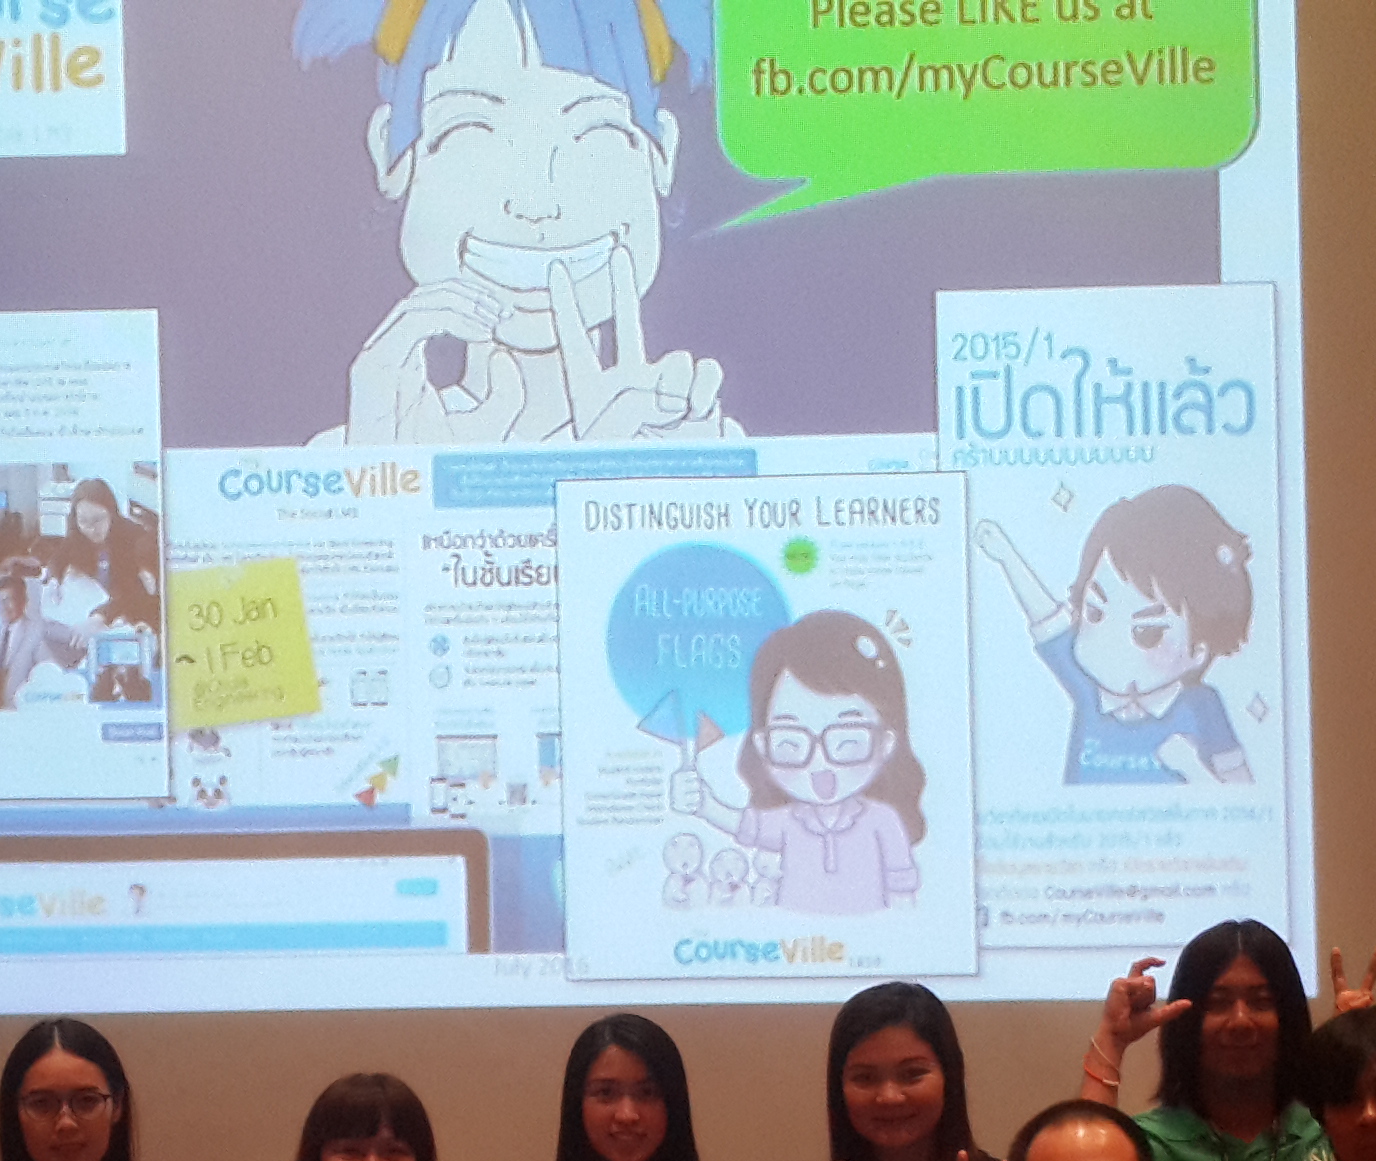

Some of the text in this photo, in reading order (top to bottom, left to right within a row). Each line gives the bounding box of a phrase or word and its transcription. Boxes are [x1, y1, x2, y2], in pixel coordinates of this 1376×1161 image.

[810, 0, 1155, 29] Please LIKE us at
[751, 47, 1217, 100] fb.com/myCourseVille
[951, 326, 1056, 367] 2015/1
[954, 346, 1256, 440] เปิดให้แล้ว
[217, 461, 421, 501] CourseVille
[187, 601, 224, 632] 30
[232, 597, 279, 626] Jan
[219, 639, 273, 670] Feb
[673, 934, 845, 965] CourseVille
